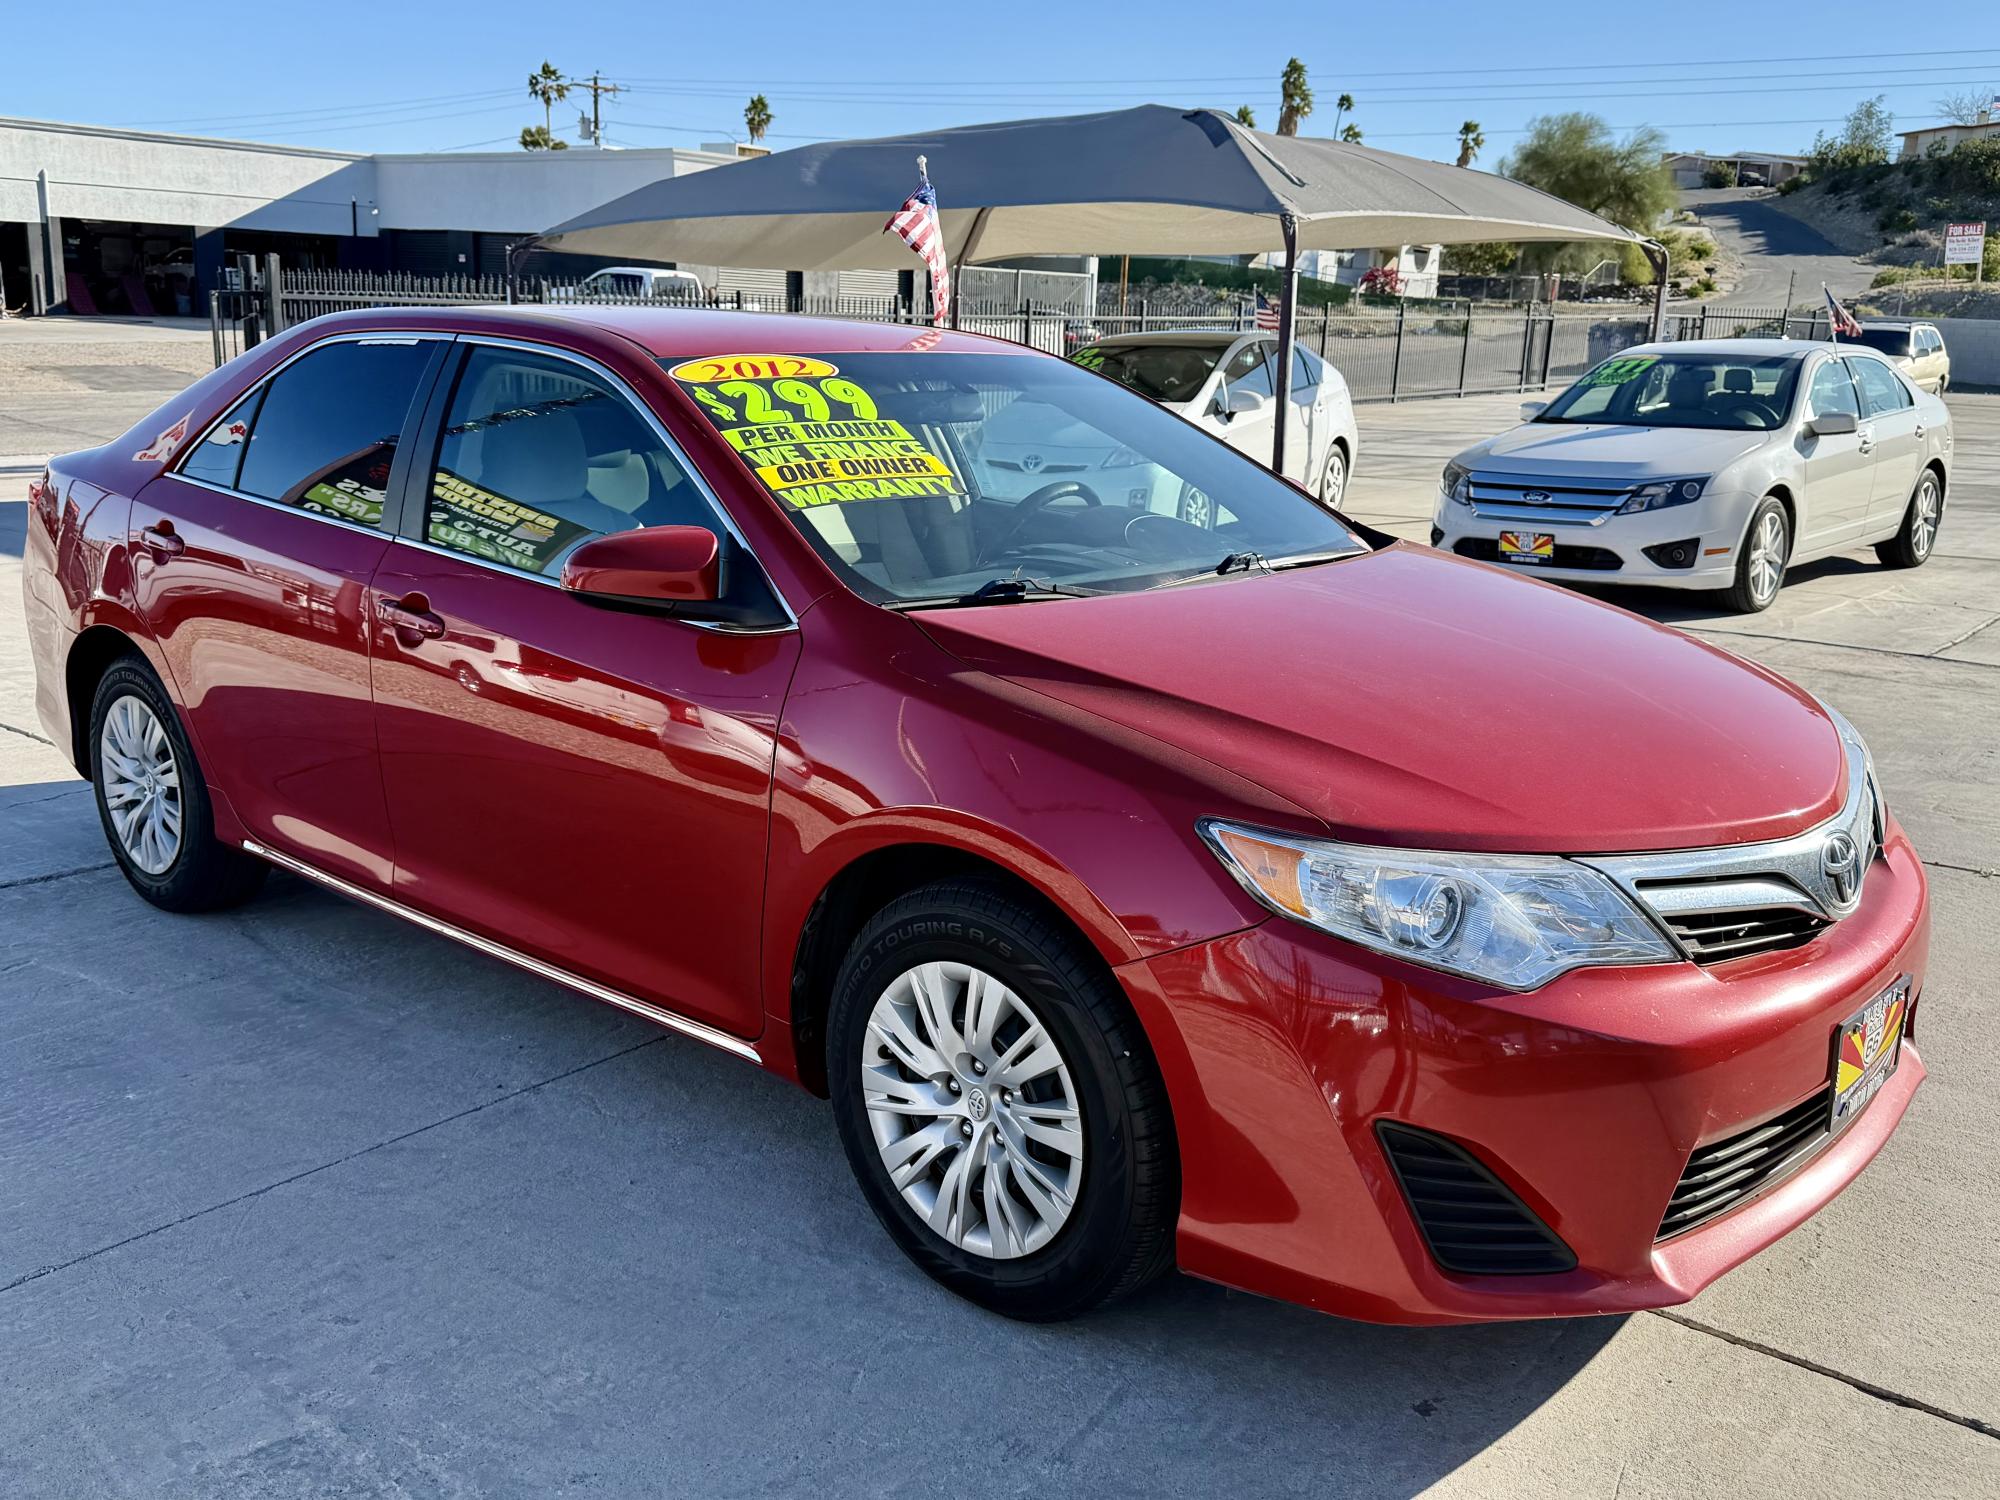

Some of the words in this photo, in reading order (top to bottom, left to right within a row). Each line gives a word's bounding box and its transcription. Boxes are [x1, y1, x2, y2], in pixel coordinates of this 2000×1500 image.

[1949, 226, 1963, 236] FOR
[1964, 225, 1982, 235] SALE
[701, 359, 813, 380] 2012
[693, 378, 878, 422] $299
[737, 426, 794, 446] PER
[804, 422, 895, 441] MONTH
[743, 445, 802, 466] WE
[808, 440, 933, 461] FINANCE
[776, 460, 838, 484] ONE
[840, 456, 931, 477] OWNER
[777, 477, 958, 508] WARRANTY
[873, 921, 962, 954] TOURING
[968, 928, 1012, 958] A/S
[1865, 1032, 1881, 1058] 66
